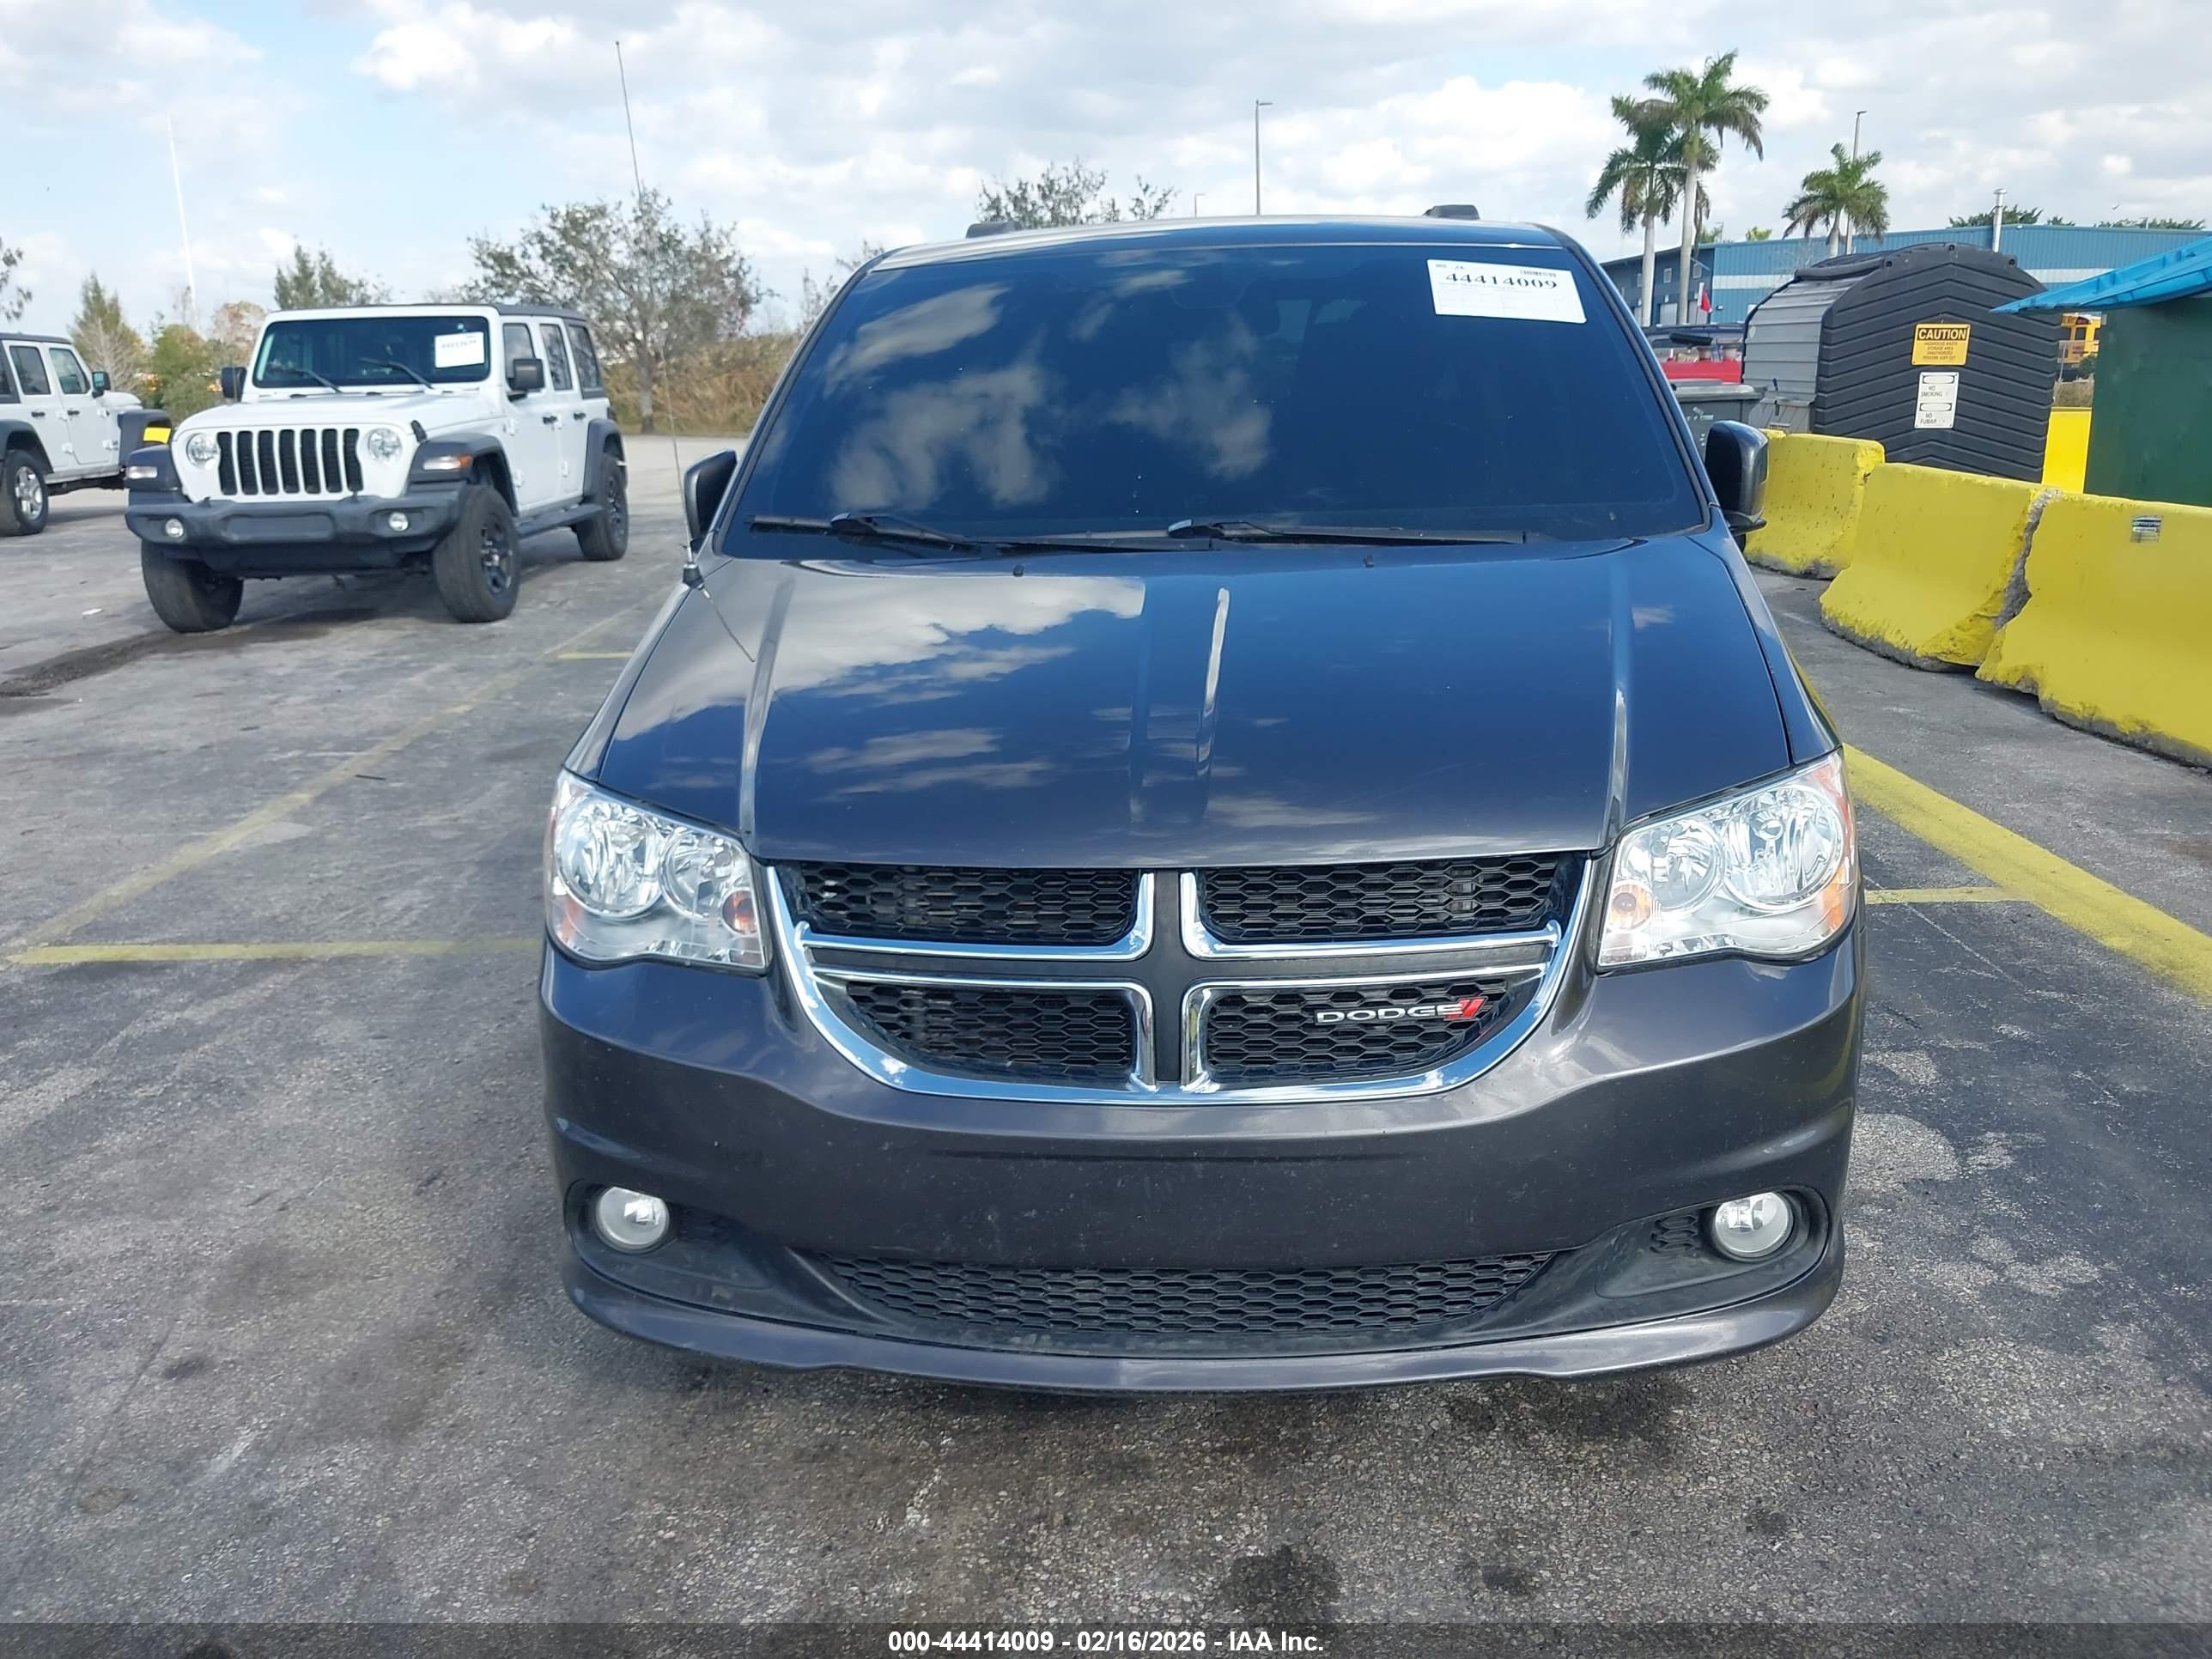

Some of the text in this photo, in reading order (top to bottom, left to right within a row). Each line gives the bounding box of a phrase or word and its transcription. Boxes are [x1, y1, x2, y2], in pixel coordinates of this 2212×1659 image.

[1445, 273, 1557, 289] 44414009
[1918, 329, 1966, 340] CAUTION
[1316, 1003, 1464, 1024] DODGE
